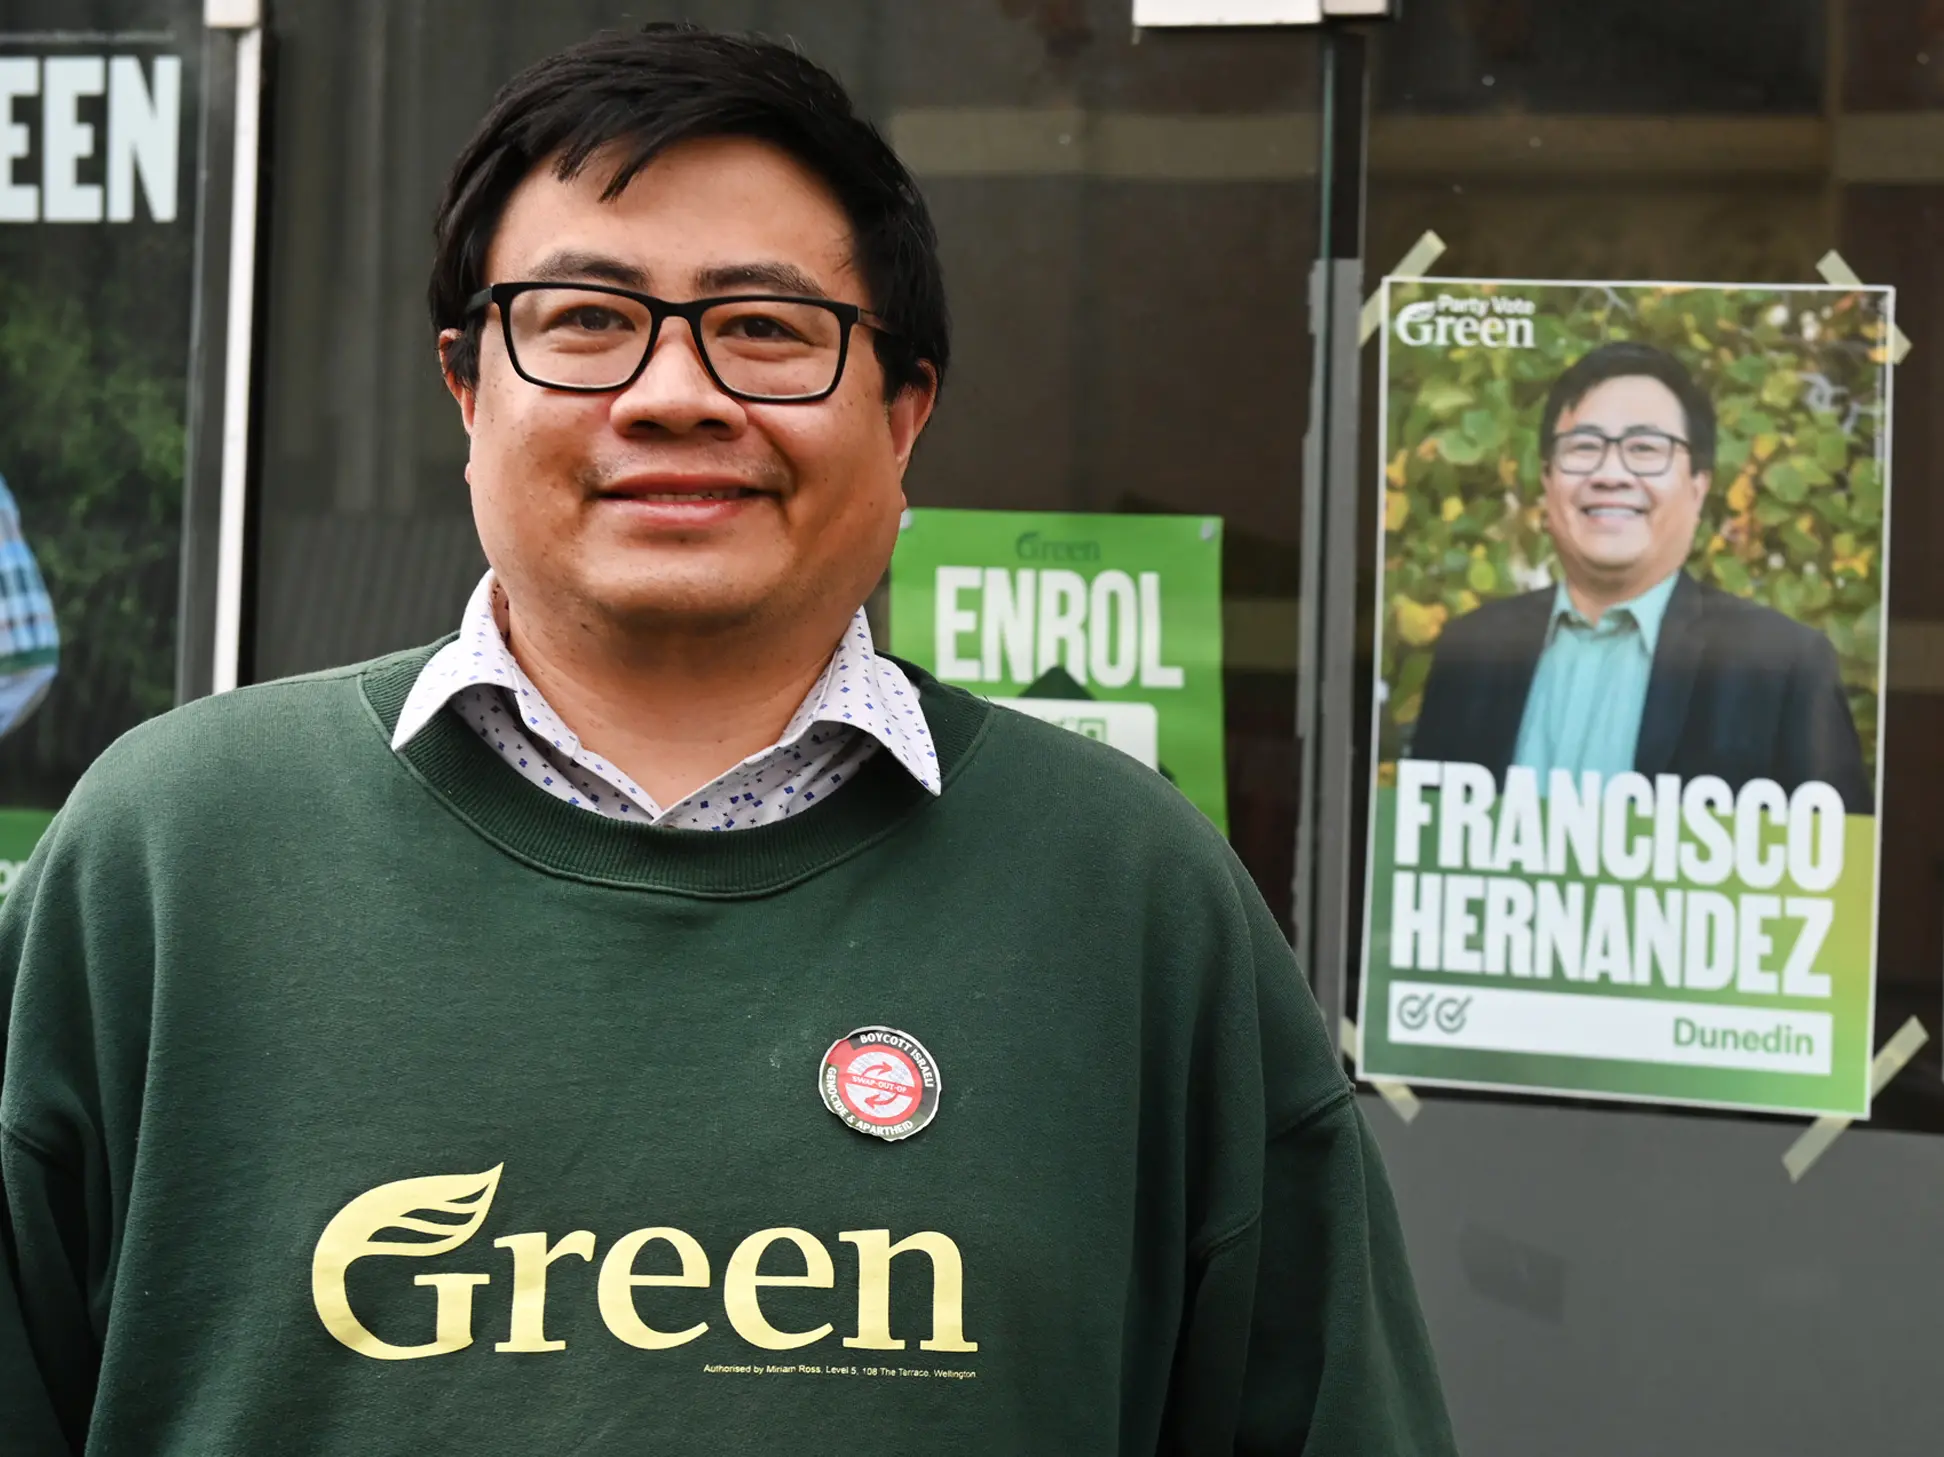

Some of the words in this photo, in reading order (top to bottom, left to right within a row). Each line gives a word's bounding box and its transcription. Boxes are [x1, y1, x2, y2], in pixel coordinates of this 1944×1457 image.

[1395, 301, 1537, 349] Green
[1437, 293, 1490, 317] Party
[1490, 296, 1536, 316] Vote
[1015, 531, 1101, 562] Green
[935, 565, 1184, 689] ENROL
[1394, 758, 1846, 892] FRANCISCO
[1390, 870, 1835, 998] HERNANDEZ
[860, 1032, 912, 1052] BOYCOTT
[910, 1048, 934, 1088] ISRAELI
[1673, 1017, 1815, 1057] Dunedin
[826, 1066, 849, 1117] GENOCIDE
[846, 1114, 856, 1124] &
[855, 1120, 914, 1136] APARTHEID
[311, 1161, 979, 1361] Green
[703, 1364, 752, 1373] Authorised
[753, 1365, 765, 1376] by
[825, 1366, 850, 1375] Level
[862, 1367, 878, 1376] 108
[880, 1367, 896, 1377] The
